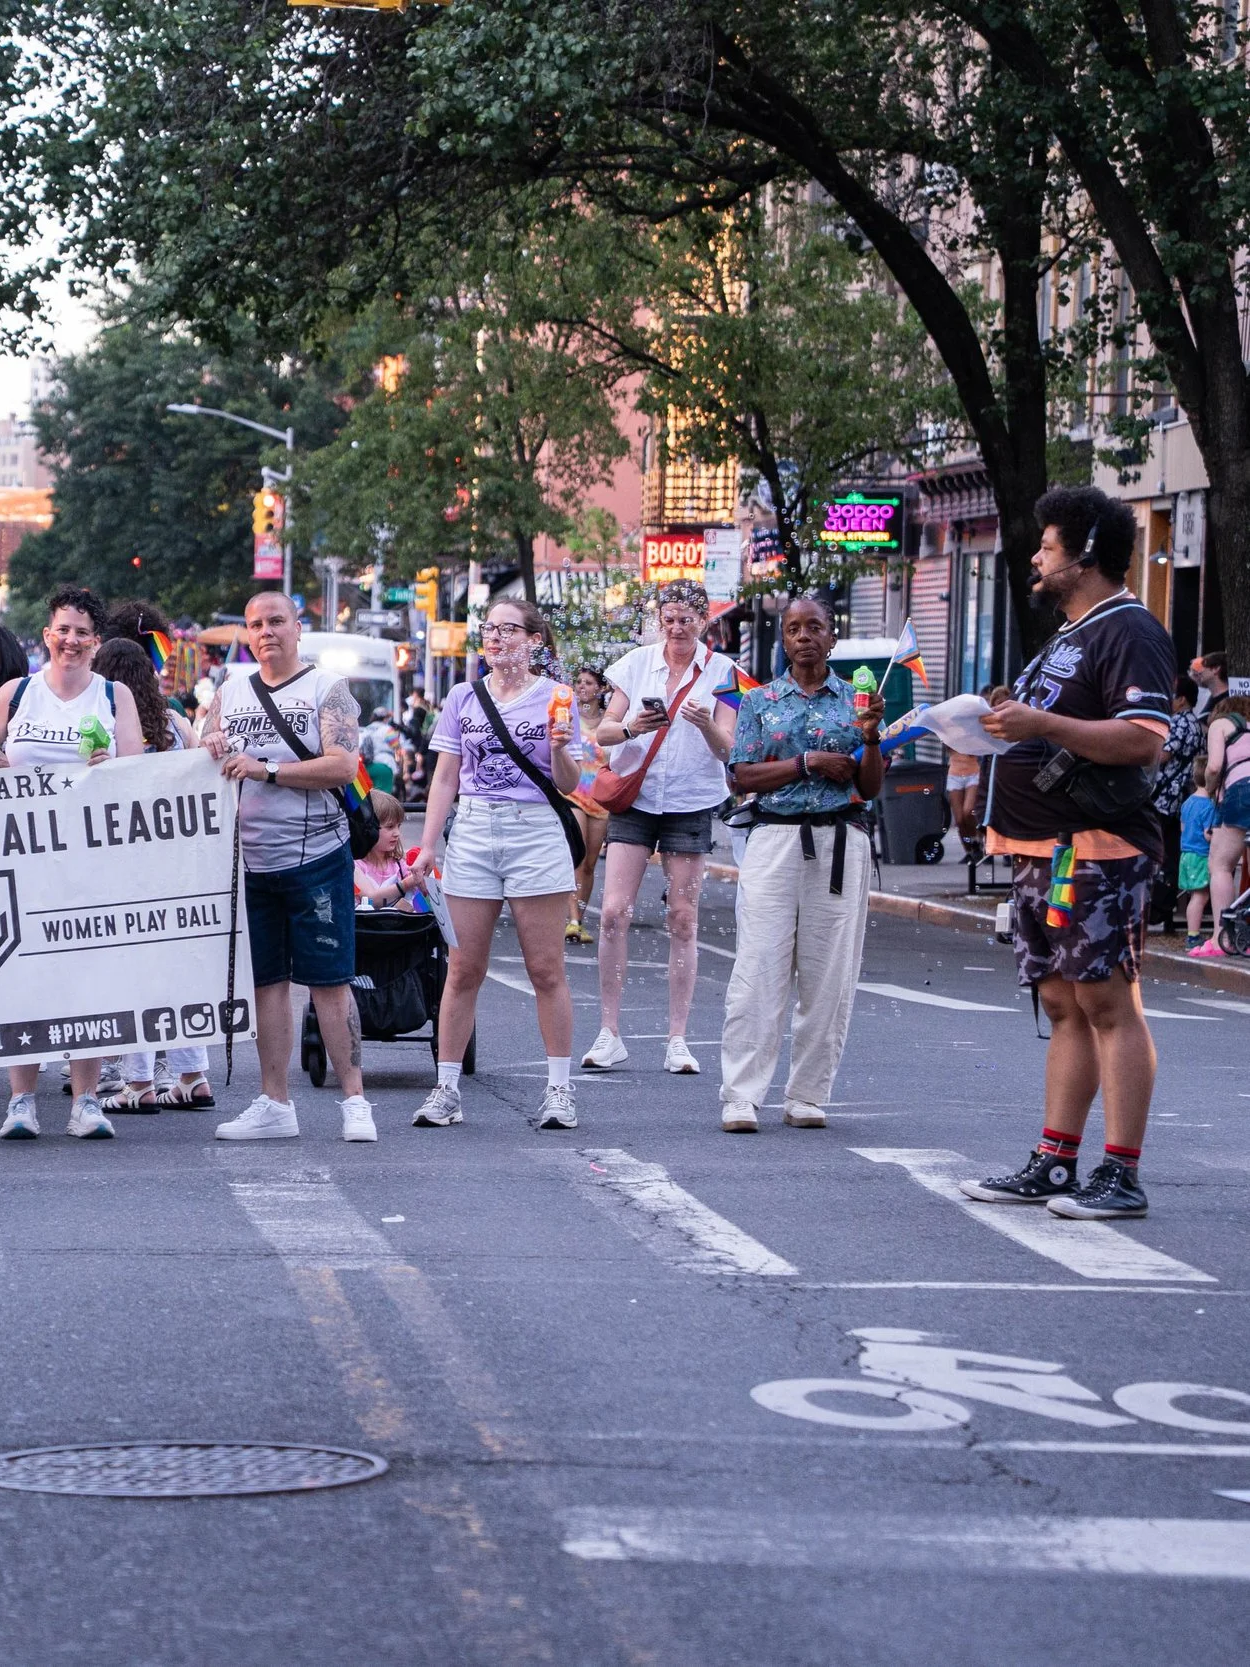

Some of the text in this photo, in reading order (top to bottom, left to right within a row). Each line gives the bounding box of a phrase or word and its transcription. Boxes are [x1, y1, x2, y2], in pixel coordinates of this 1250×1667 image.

[824, 517, 885, 532] QUEEN
[1239, 681, 1250, 689] NO
[16, 722, 83, 742] Bomb
[228, 710, 309, 737] BOMBRS
[460, 716, 546, 741] Bodeg Cats
[83, 792, 221, 849] LEAGUE
[42, 904, 222, 943] WOMEN PLAY BALL
[48, 1018, 122, 1045] #PPWSL
